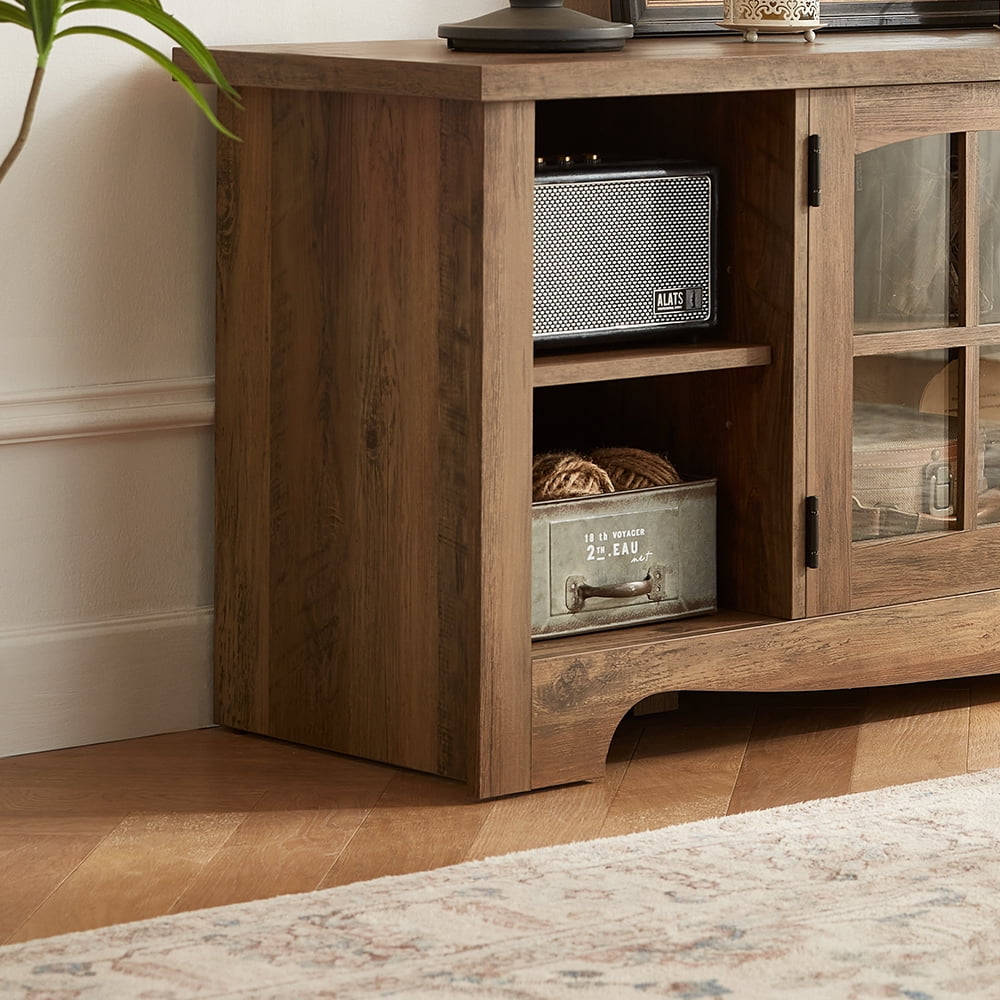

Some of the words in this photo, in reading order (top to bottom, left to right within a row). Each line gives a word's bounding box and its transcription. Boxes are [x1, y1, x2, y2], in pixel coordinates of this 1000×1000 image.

[657, 290, 684, 308] ALATS
[599, 531, 608, 541] th
[612, 528, 645, 539] VOYAGER
